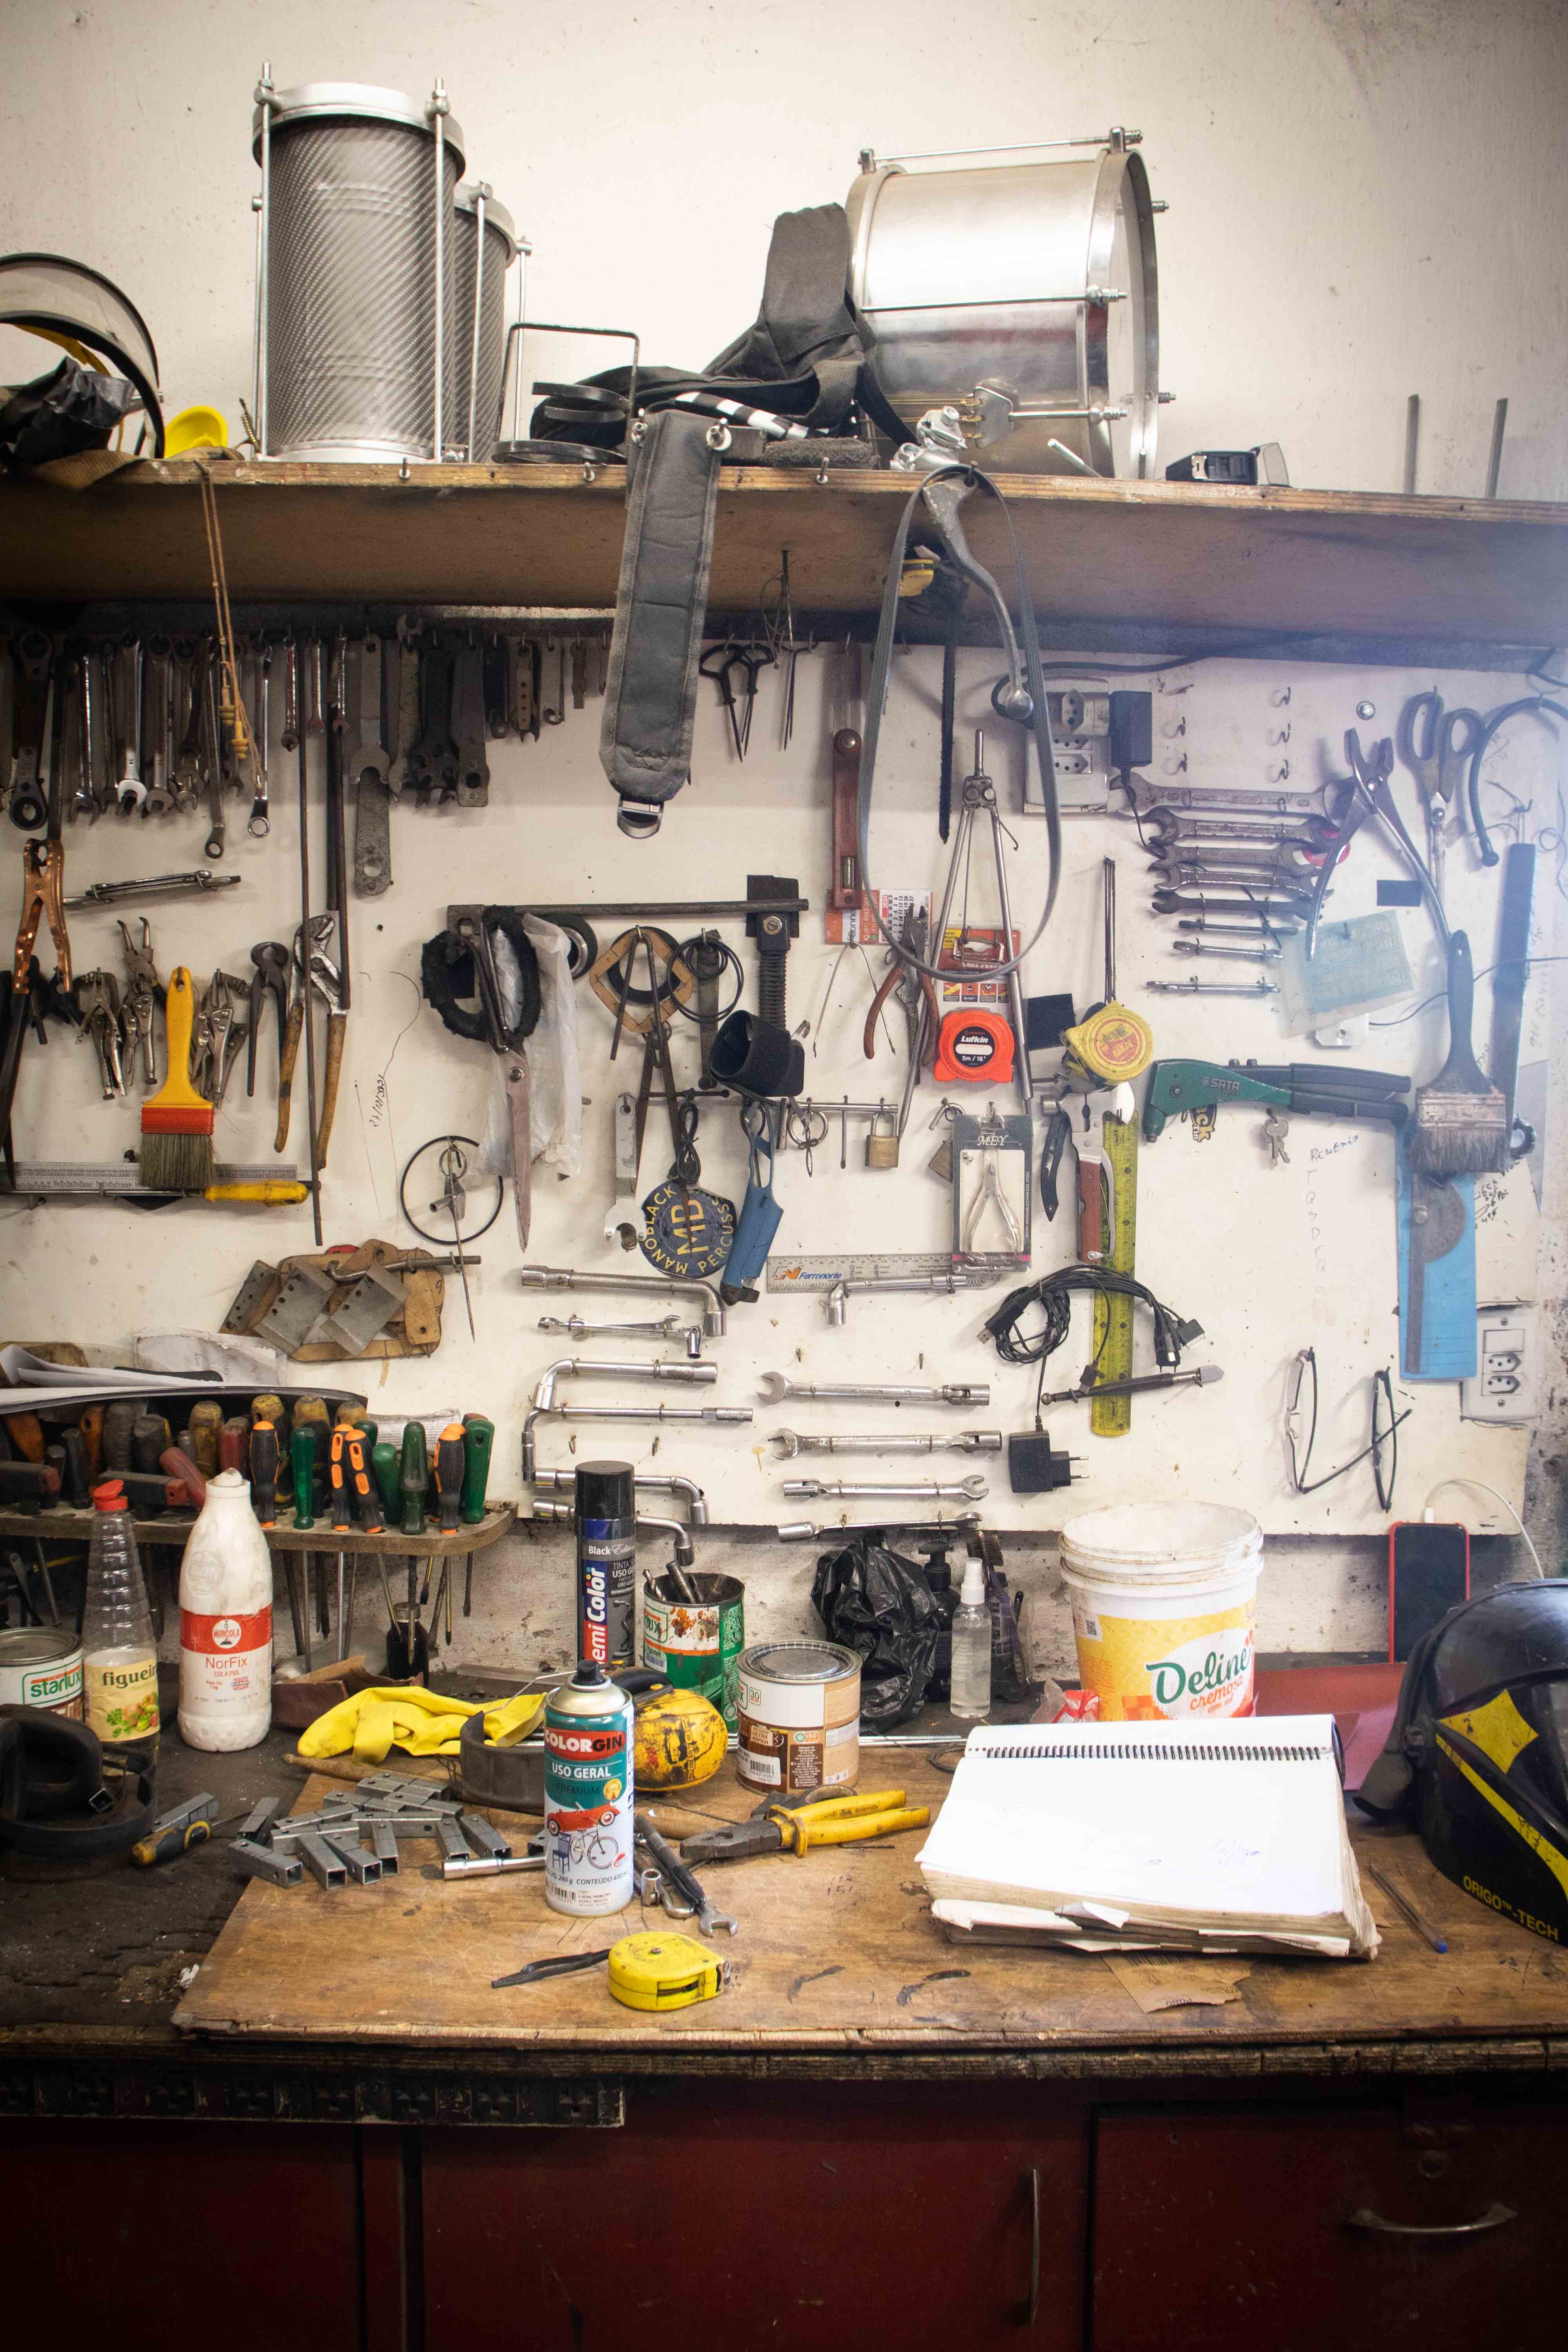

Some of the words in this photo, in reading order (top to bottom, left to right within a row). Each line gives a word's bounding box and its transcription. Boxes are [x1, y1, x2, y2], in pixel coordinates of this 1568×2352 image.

[1211, 1078, 1240, 1091] SATA
[799, 1272, 842, 1280] Ferronorte
[588, 1546, 611, 1555] Black
[612, 1569, 627, 1578] USO
[214, 1629, 240, 1638] NORCOLA
[205, 1656, 248, 1669] NorFix
[1146, 1646, 1251, 1704] Deline
[750, 1689, 760, 1700] 30
[1190, 1675, 1243, 1711] cremosa
[1207, 1703, 1222, 1713] com
[545, 1730, 623, 1753] COLORGIN
[552, 1762, 571, 1777] USO
[574, 1766, 611, 1779] GERAL
[557, 1783, 600, 1796] PREMIUM
